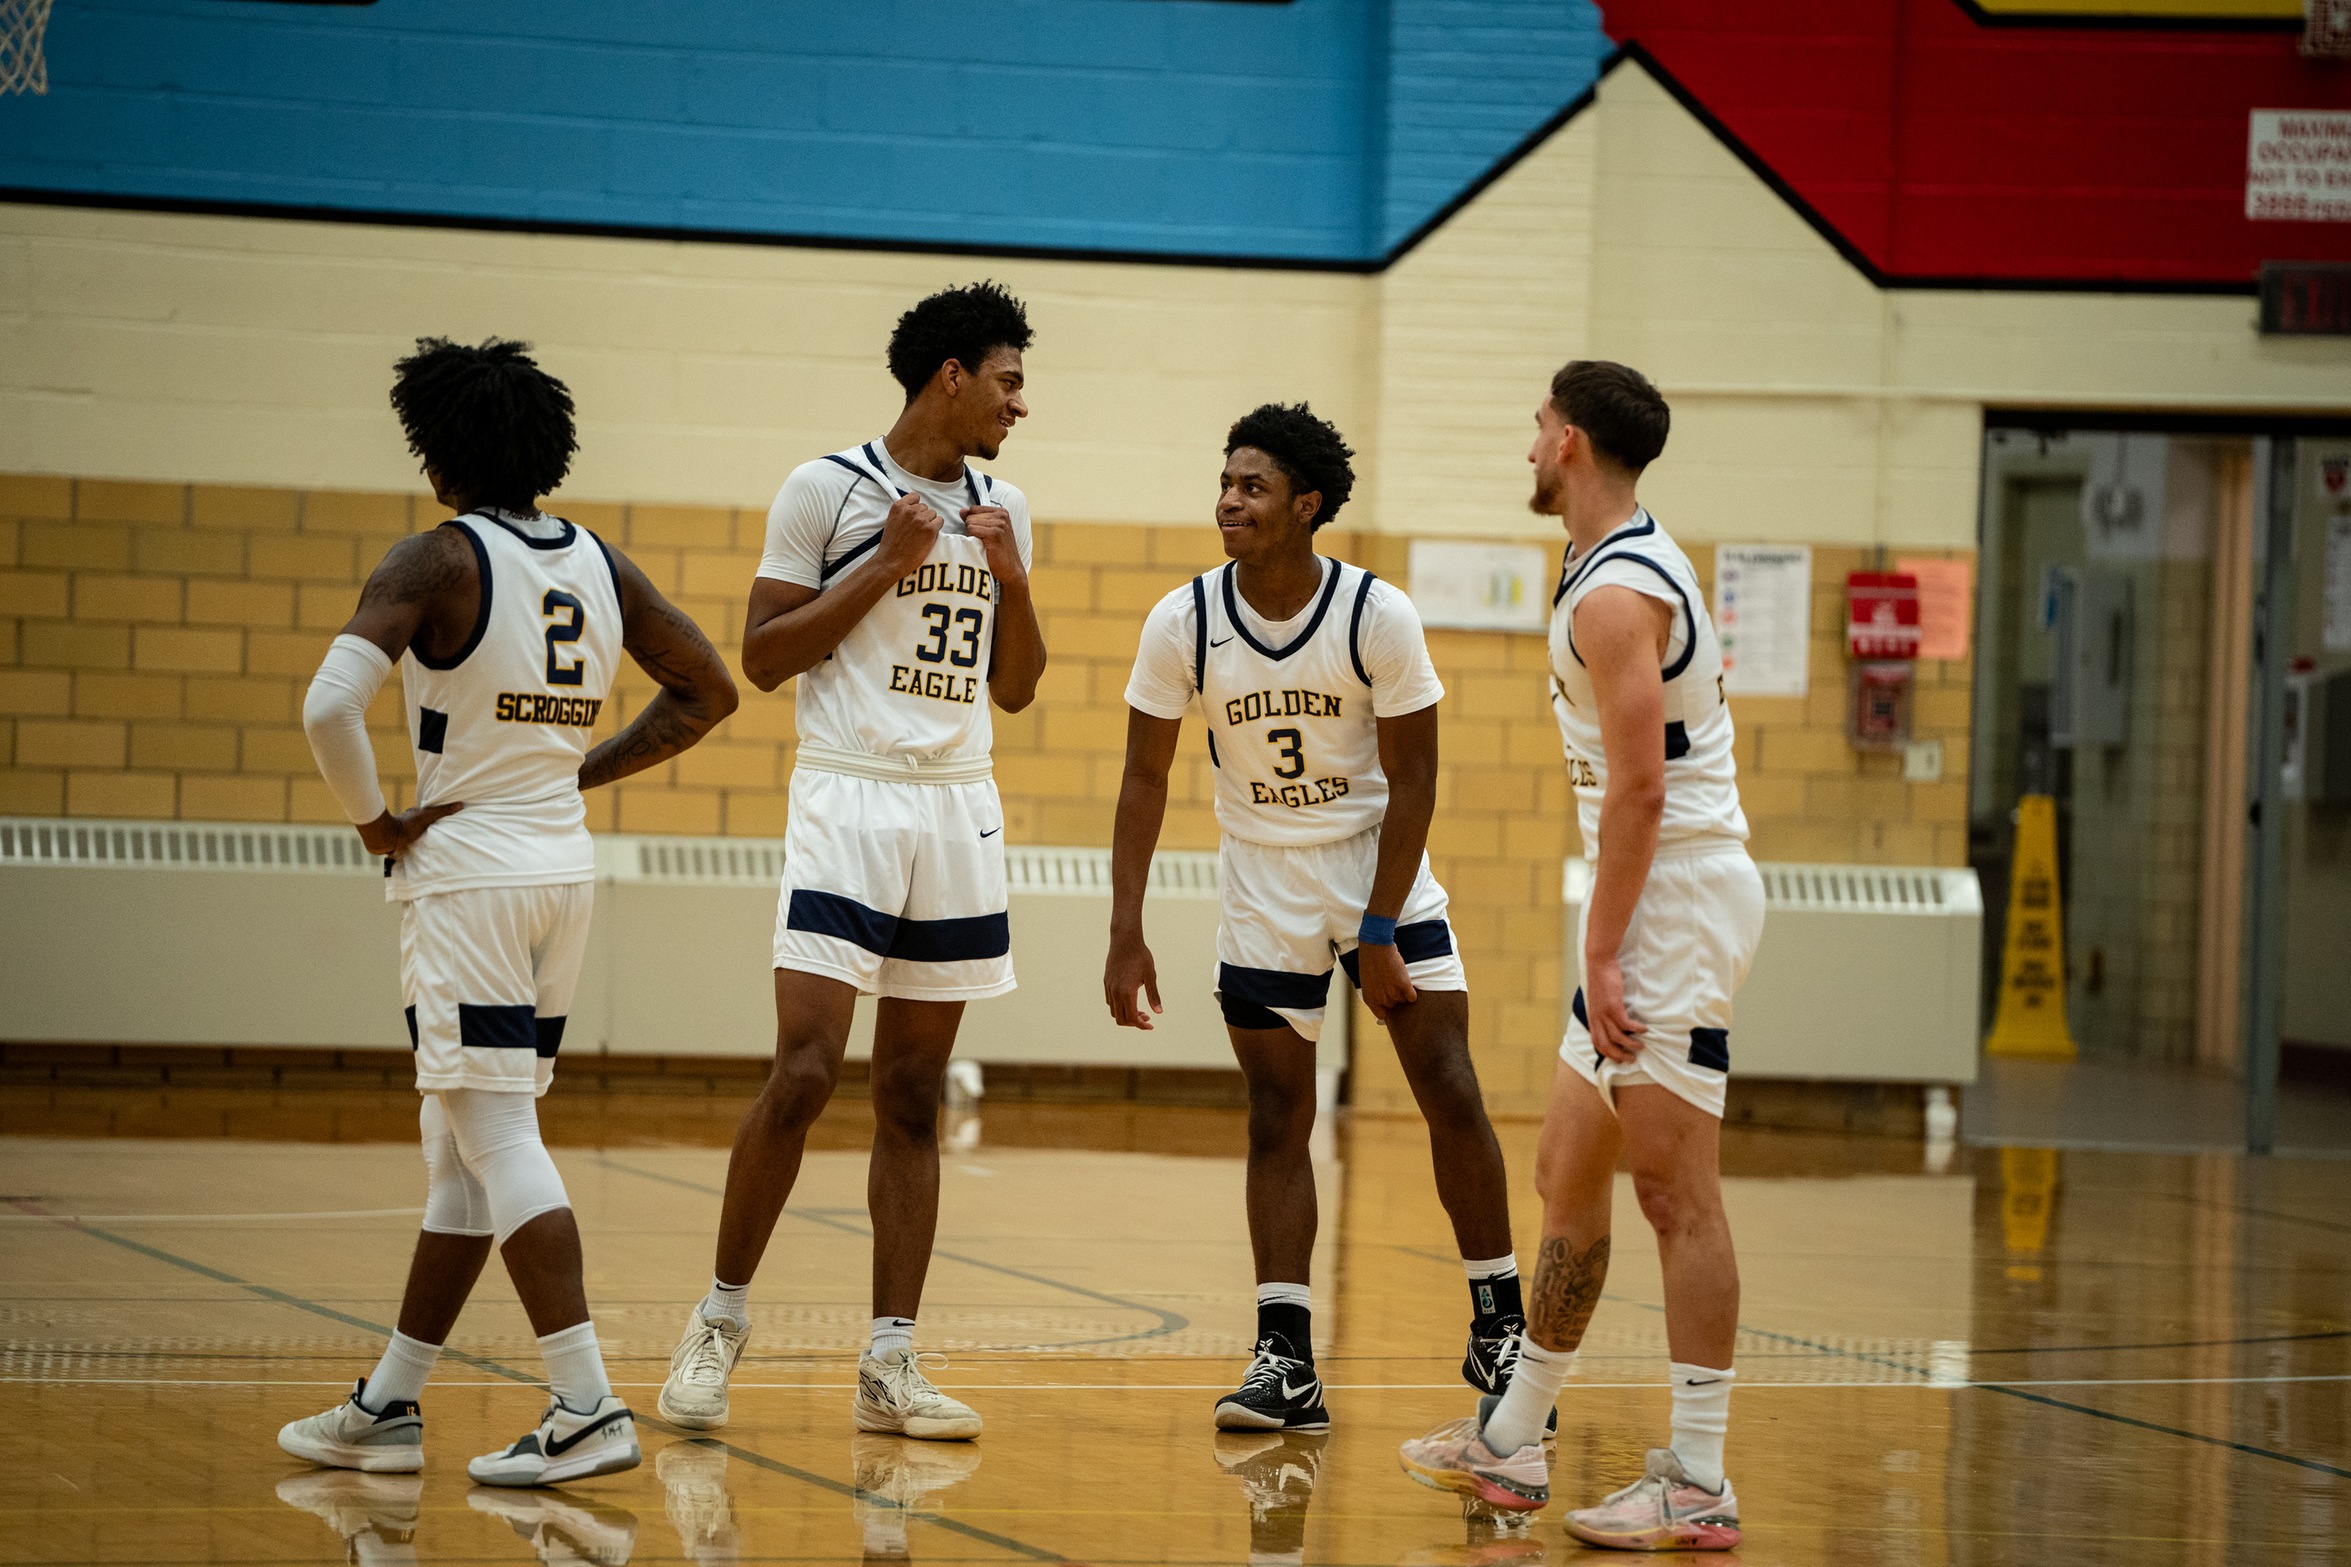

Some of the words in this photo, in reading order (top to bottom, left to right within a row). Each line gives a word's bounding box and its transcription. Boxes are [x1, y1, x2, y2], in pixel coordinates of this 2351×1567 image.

[897, 562, 992, 603] GOLDE
[541, 587, 586, 688] 2
[915, 602, 984, 669] 33
[889, 664, 978, 704] EAGLE
[1225, 688, 1343, 727] GOLDEN
[1266, 727, 1306, 780] 3
[1250, 776, 1350, 809] EAGLES
